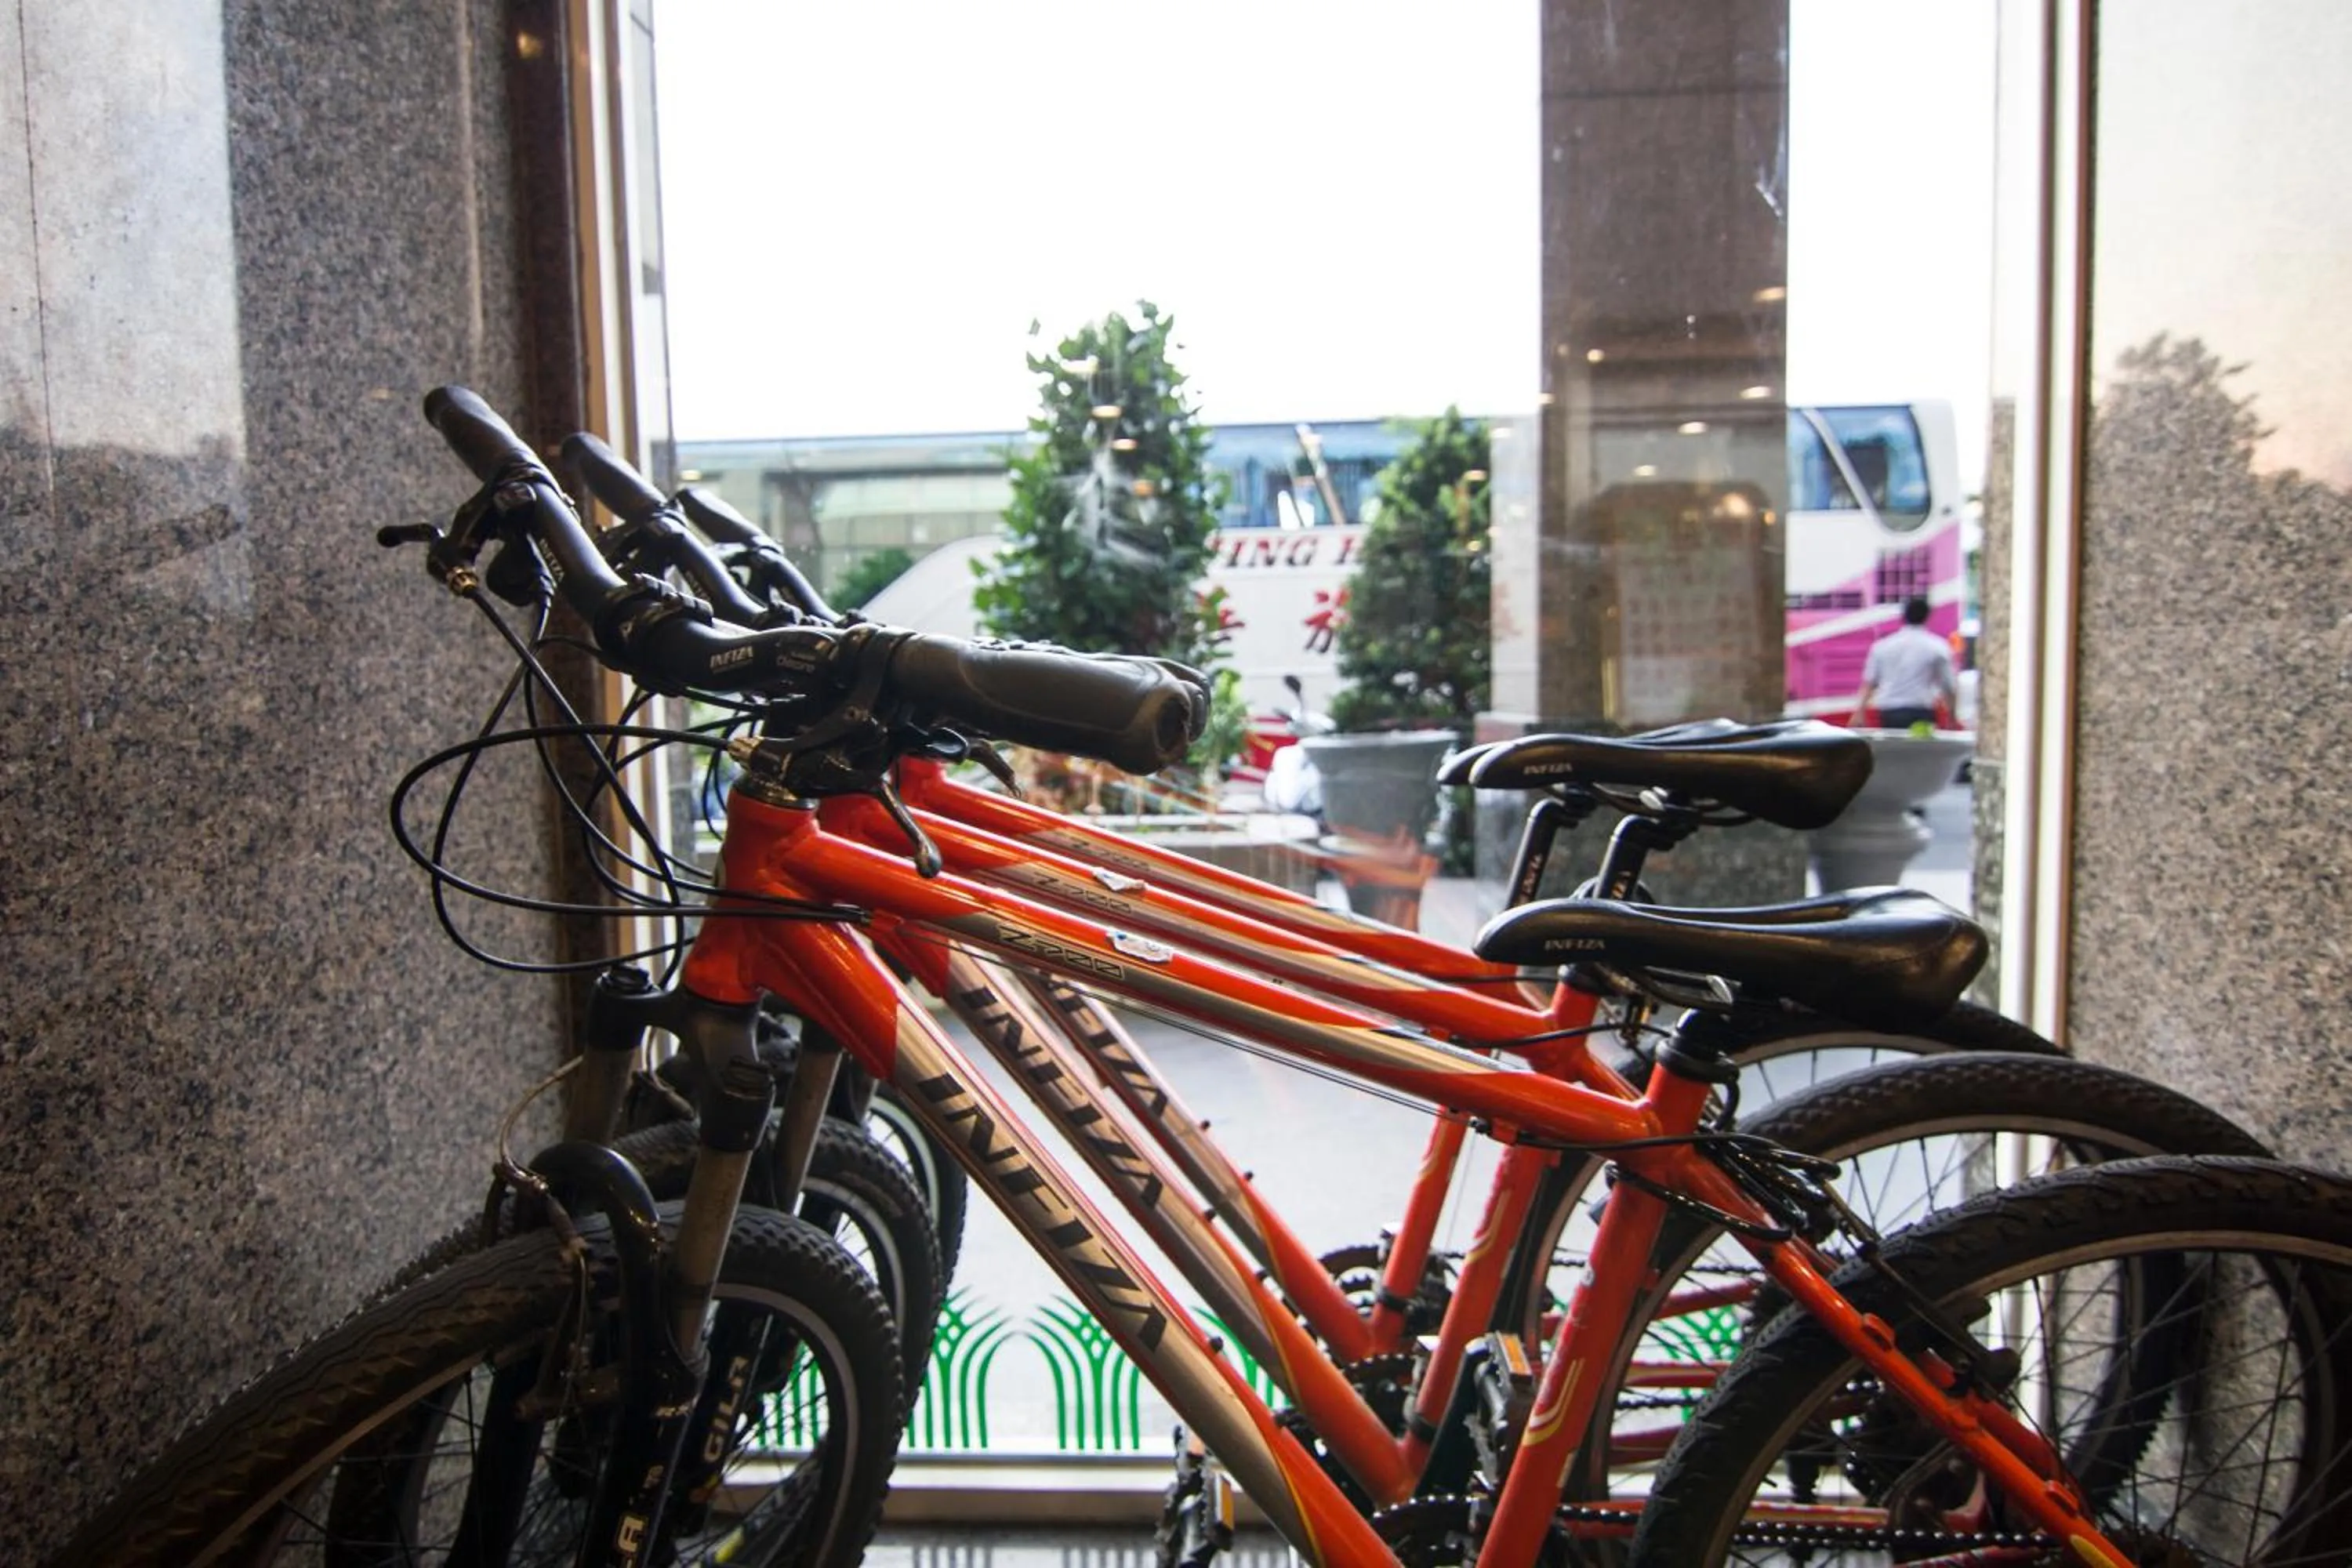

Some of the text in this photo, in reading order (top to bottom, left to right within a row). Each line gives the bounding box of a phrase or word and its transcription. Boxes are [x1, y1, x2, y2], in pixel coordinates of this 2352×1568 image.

[710, 644, 754, 668] INFIZA
[1523, 763, 1573, 775] INFIZA
[1544, 938, 1606, 950] INFIZA
[960, 985, 1163, 1209] INFIZA
[918, 1073, 1167, 1352] INFIZA
